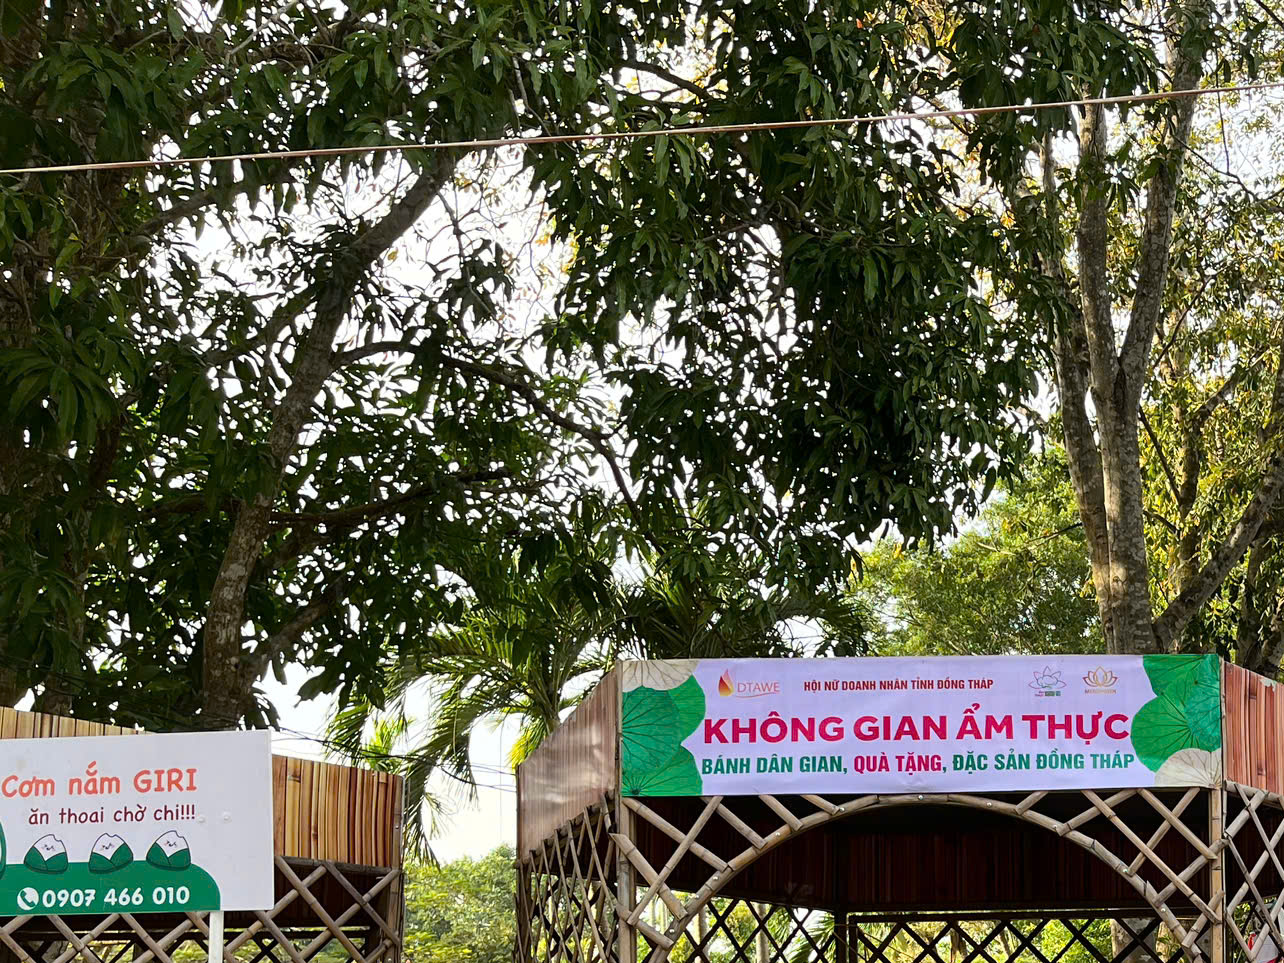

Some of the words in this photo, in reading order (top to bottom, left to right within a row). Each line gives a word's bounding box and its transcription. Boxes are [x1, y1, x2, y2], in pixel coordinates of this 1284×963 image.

[737, 681, 780, 693] DTAWE
[804, 680, 821, 693] HỘI
[824, 679, 840, 691] NỮ
[841, 681, 876, 691] DOANH
[879, 678, 908, 690] NHÂN
[911, 676, 934, 690] TỈNH
[937, 676, 966, 690] ĐỒNG
[968, 676, 993, 689] THÁP
[704, 710, 845, 744] KHÔNG
[853, 714, 947, 742] GIAN
[956, 702, 1014, 740] ẨM
[1021, 711, 1130, 745] THỰC
[701, 754, 751, 775] BÁNH
[756, 754, 793, 773] DÂN
[799, 755, 848, 775] GIAN,
[853, 752, 889, 773] QUÀ
[895, 752, 947, 775] TẶNG,
[952, 751, 988, 775] ĐẶC
[994, 749, 1030, 770] SẢN
[1035, 748, 1085, 770] ĐỒNG
[1090, 750, 1135, 769] THÁP
[1, 775, 55, 797] Cơm
[68, 761, 120, 795] nắm
[133, 768, 197, 793] GIRI
[28, 807, 49, 825] ăn
[59, 807, 104, 824] thoai
[113, 804, 146, 822] chờ
[153, 804, 196, 821] chi!!!
[42, 888, 96, 908] 0907
[104, 887, 144, 906] 466
[152, 886, 190, 905] 010
